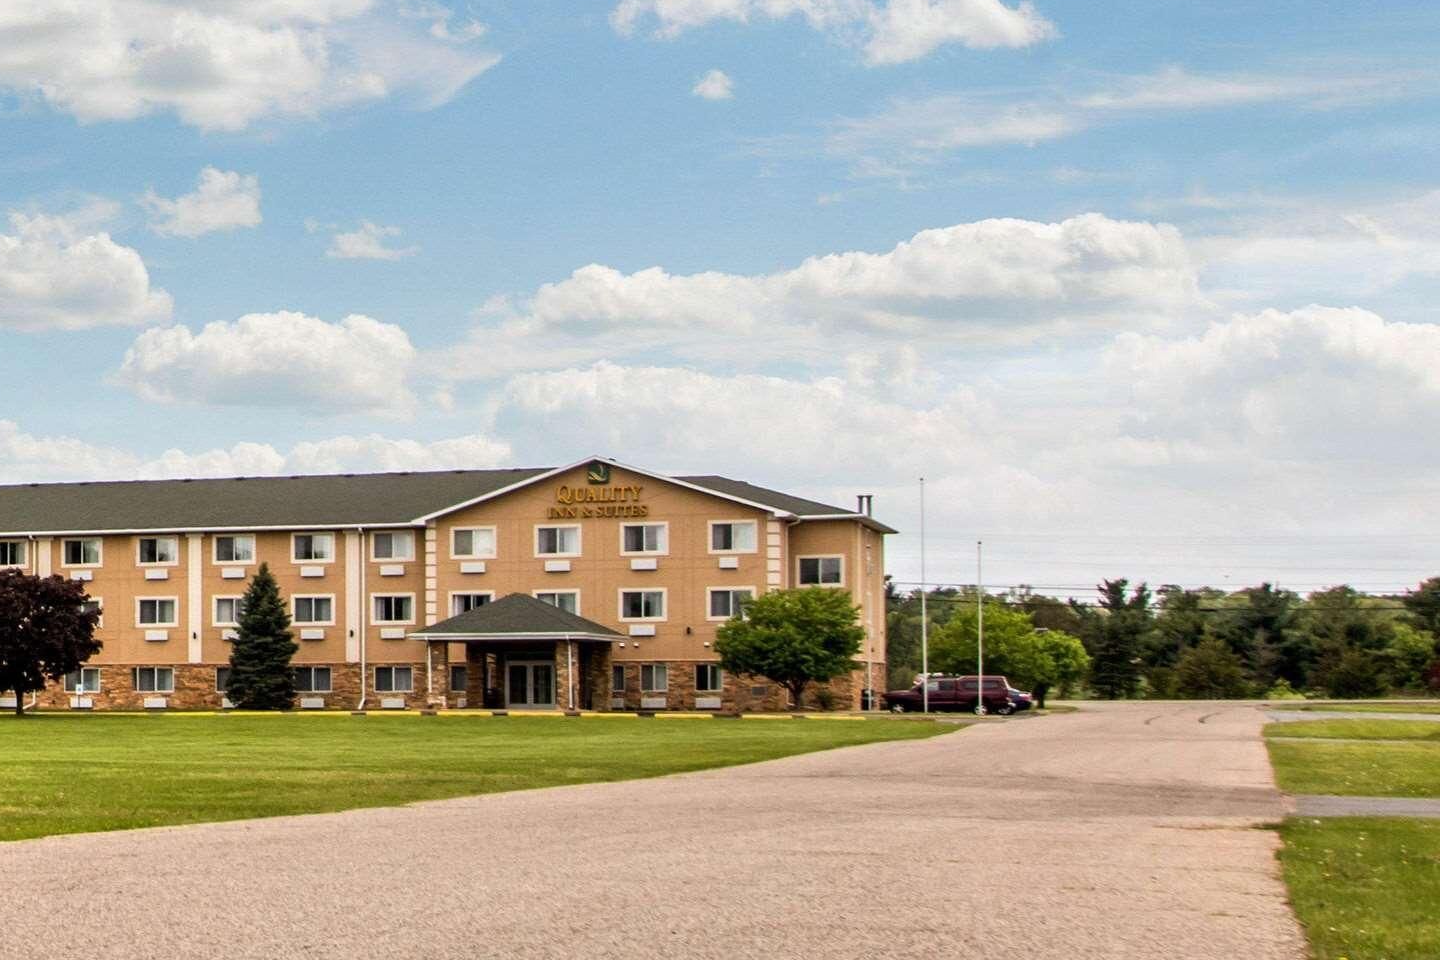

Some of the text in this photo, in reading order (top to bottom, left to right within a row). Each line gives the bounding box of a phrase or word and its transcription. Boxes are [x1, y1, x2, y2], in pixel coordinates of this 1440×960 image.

[557, 486, 642, 504] QUALITY
[548, 505, 649, 519] INN & SUITES
